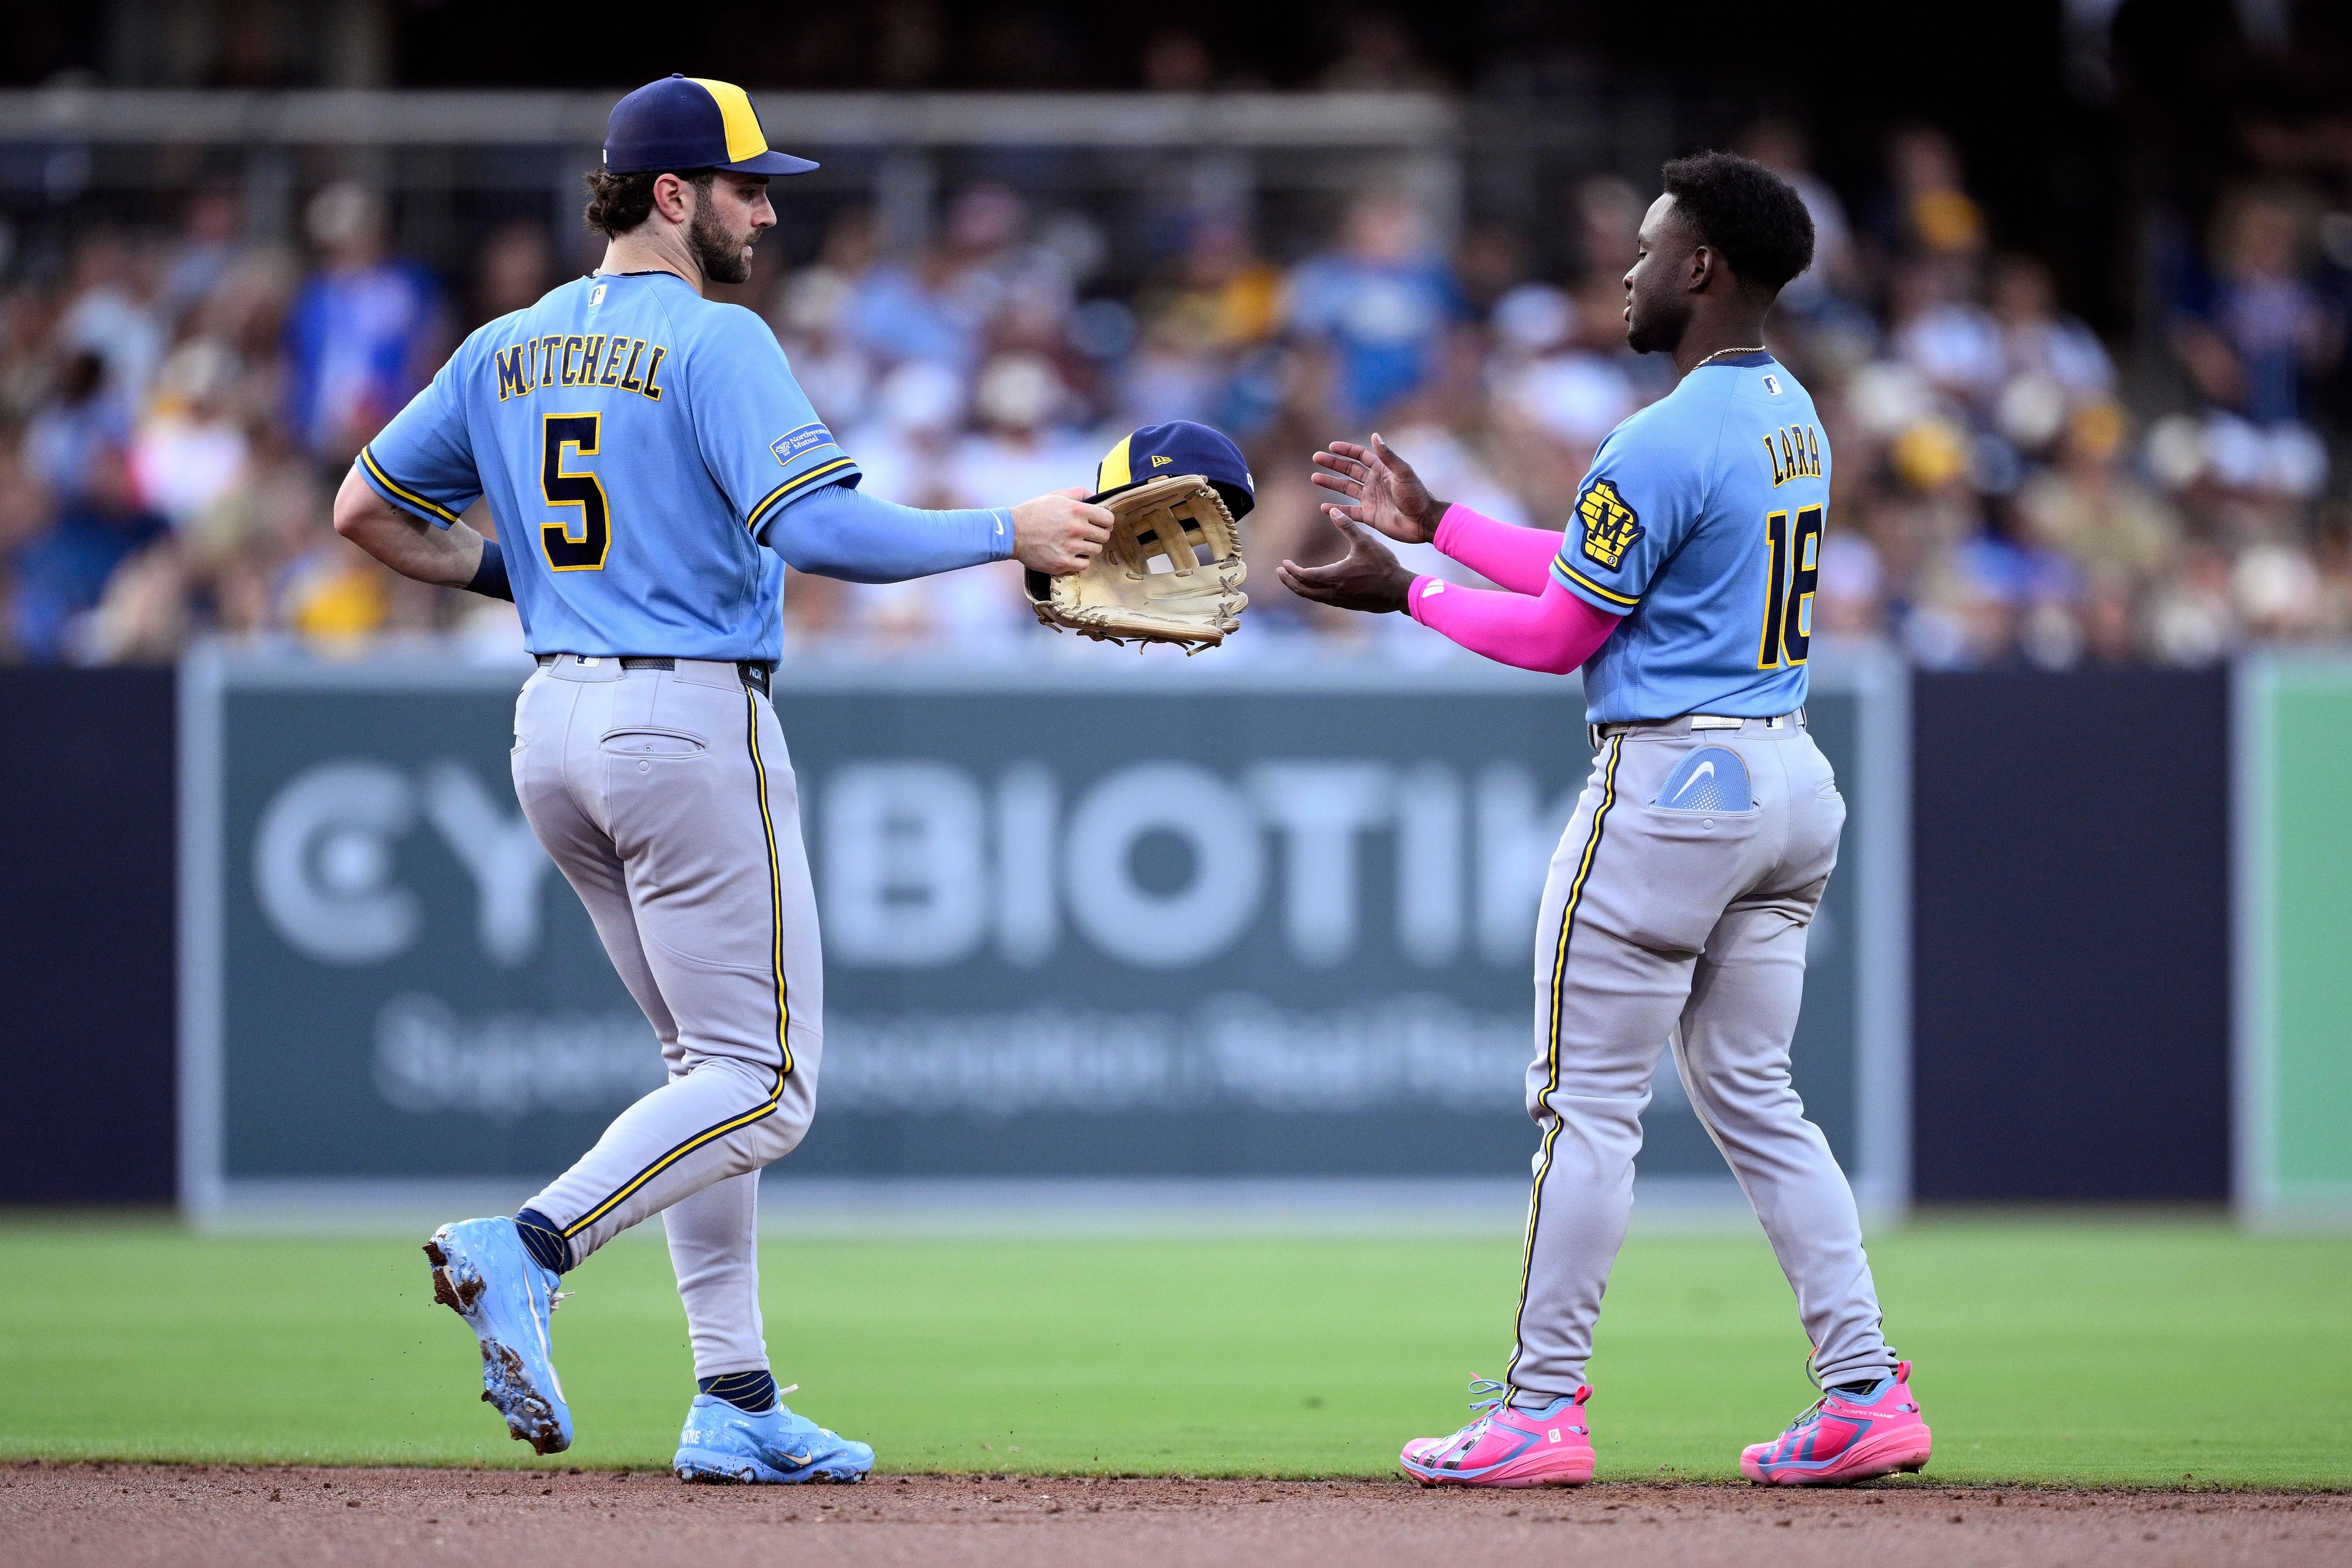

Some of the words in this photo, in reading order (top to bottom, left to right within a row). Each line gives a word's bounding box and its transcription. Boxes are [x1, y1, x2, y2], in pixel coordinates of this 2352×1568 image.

[495, 334, 668, 402] MITCHELL
[793, 435, 819, 450] Mutual
[1763, 424, 1822, 489] LARA
[540, 412, 611, 572] 5
[1589, 477, 1630, 552] M
[1758, 503, 1822, 670] 18
